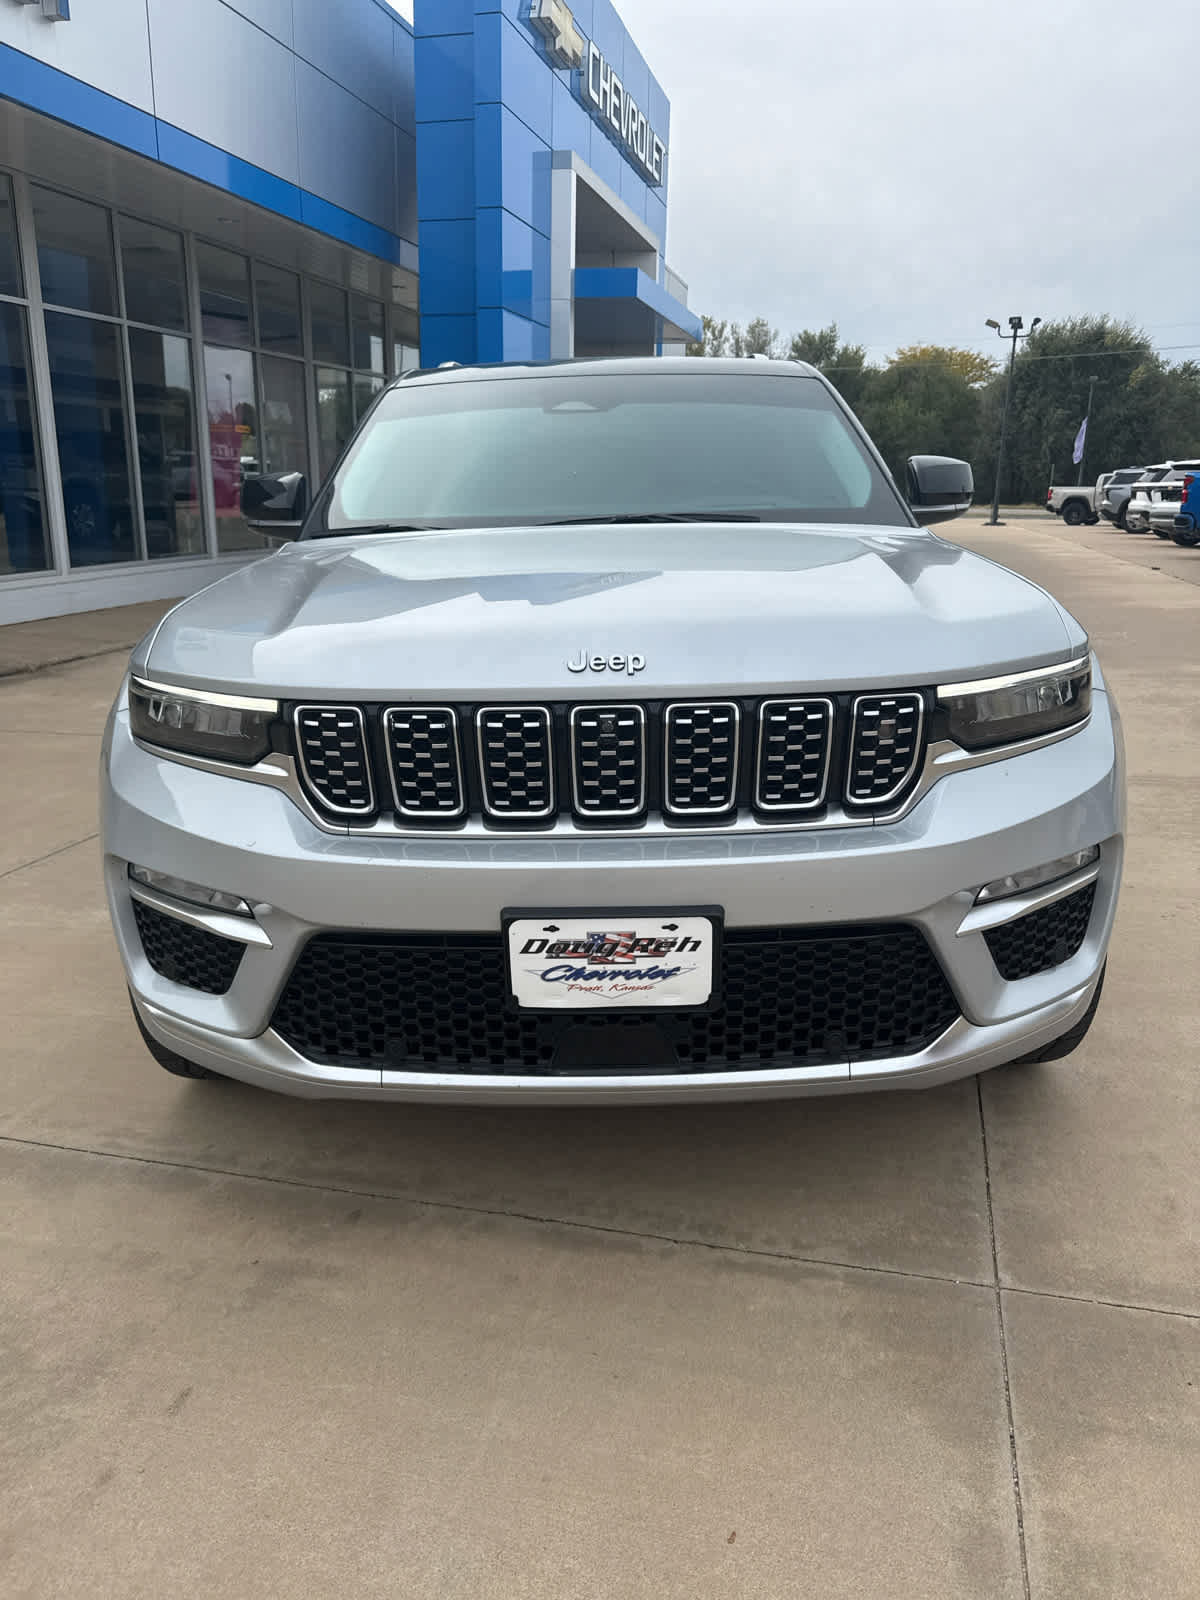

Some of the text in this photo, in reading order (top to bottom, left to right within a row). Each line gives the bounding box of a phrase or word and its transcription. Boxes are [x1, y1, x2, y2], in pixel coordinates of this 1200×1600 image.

[588, 39, 666, 187] CHEVROLET
[566, 648, 646, 675] Jeep
[519, 936, 702, 960] Doug Reh
[540, 964, 681, 982] Chevrolet
[608, 983, 654, 992] Kansas
